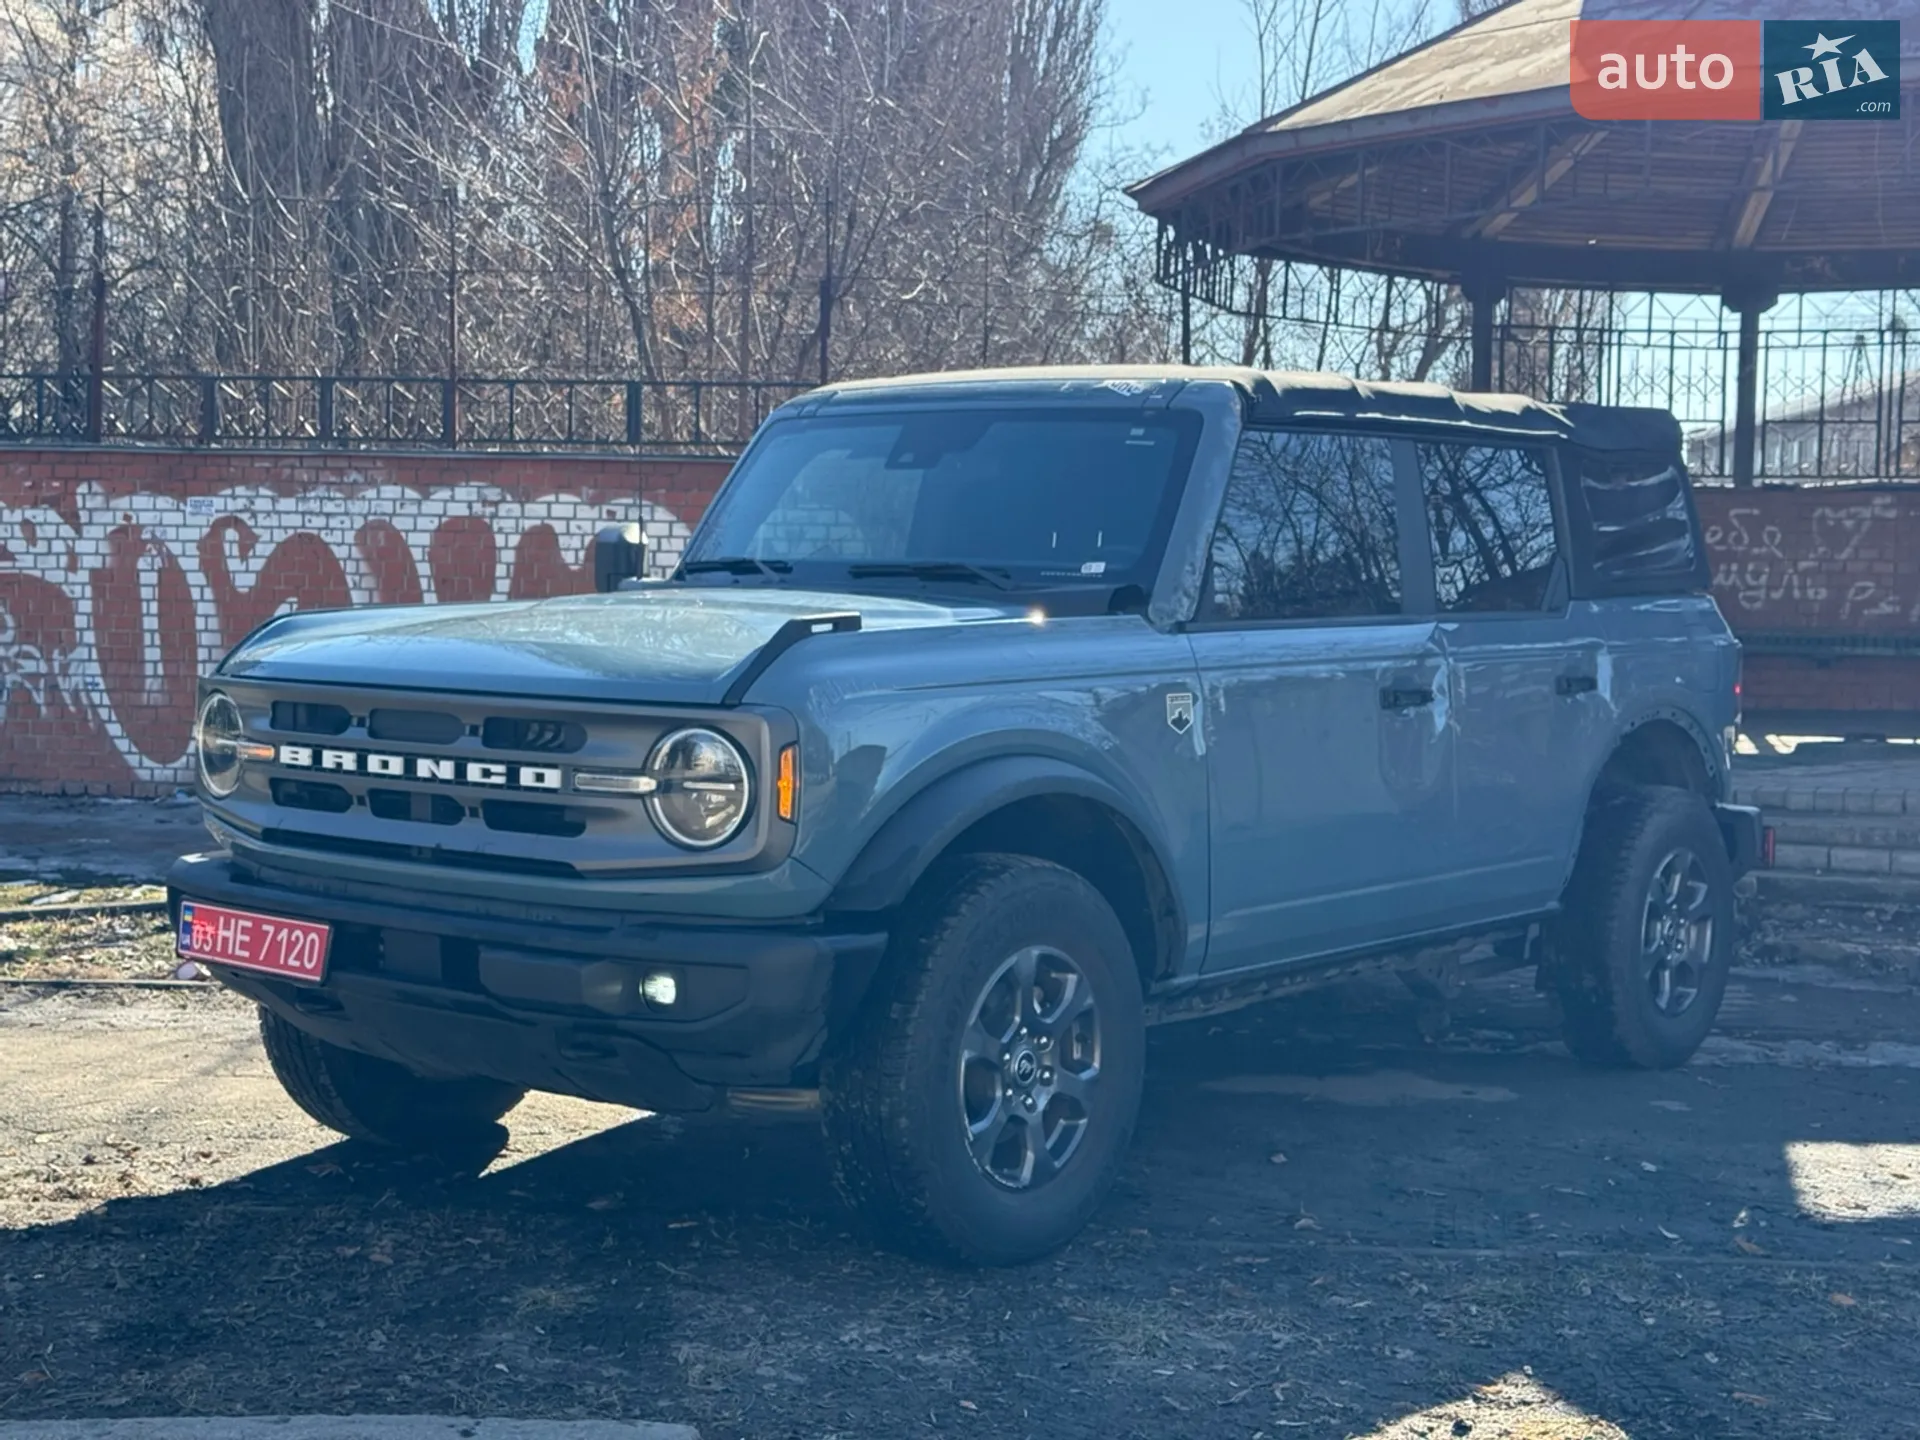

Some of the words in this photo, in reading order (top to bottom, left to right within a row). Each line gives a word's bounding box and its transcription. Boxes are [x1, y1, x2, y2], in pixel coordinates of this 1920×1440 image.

[279, 745, 562, 789] BRONCO
[216, 916, 253, 957] HE
[259, 924, 319, 969] 7120
